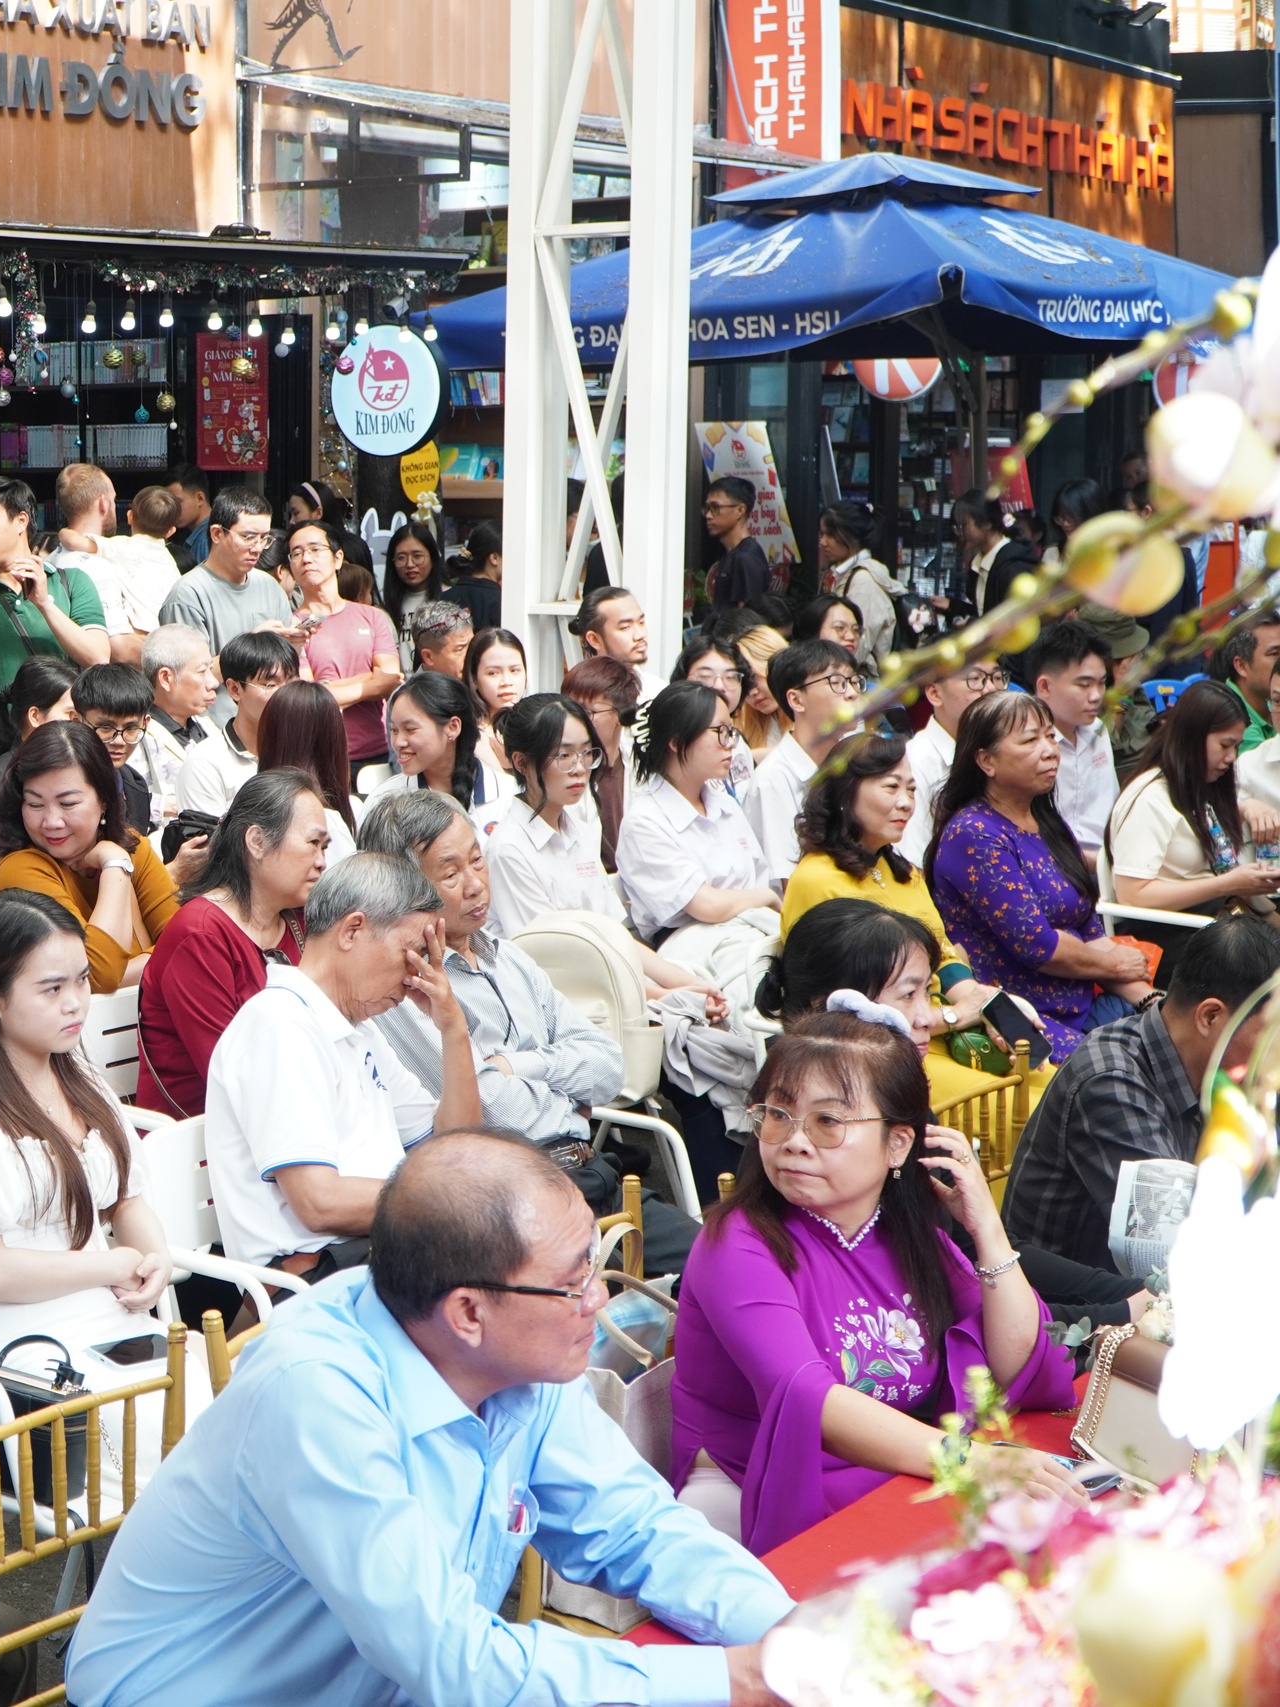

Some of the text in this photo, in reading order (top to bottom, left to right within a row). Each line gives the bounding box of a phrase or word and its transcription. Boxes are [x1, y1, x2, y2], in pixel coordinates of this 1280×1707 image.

[748, 54, 778, 150] ÁCH
[840, 66, 933, 148] NHÀ
[933, 82, 1043, 168] SÁCH
[1045, 112, 1132, 184] THÁI
[1037, 293, 1101, 323] TRƯỜNG
[1103, 300, 1130, 329] ĐẠI
[589, 323, 625, 352] ĐẠ
[733, 314, 776, 339] SEN
[355, 410, 379, 435] KIM
[424, 461, 439, 470] GIAN
